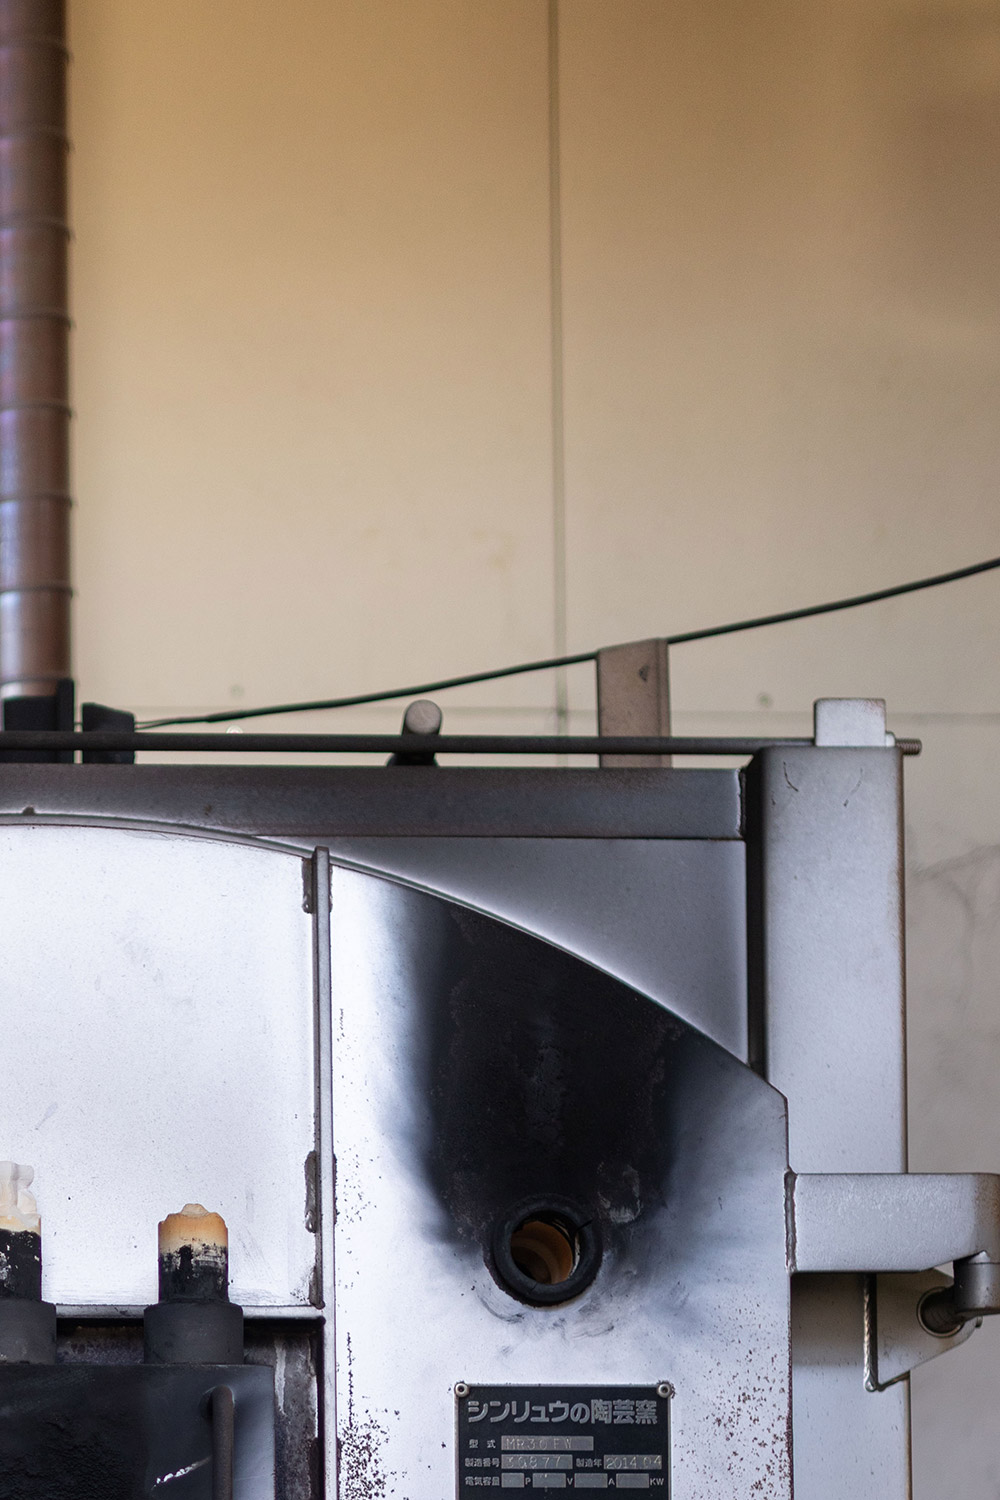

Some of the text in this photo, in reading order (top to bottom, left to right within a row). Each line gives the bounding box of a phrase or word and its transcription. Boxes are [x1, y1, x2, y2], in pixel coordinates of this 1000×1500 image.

[468, 1399, 657, 1425] シンリュウの陶芸窯
[465, 1458, 500, 1468] 製造番号
[576, 1458, 602, 1468] 製造年
[465, 1477, 500, 1486] 電気容量
